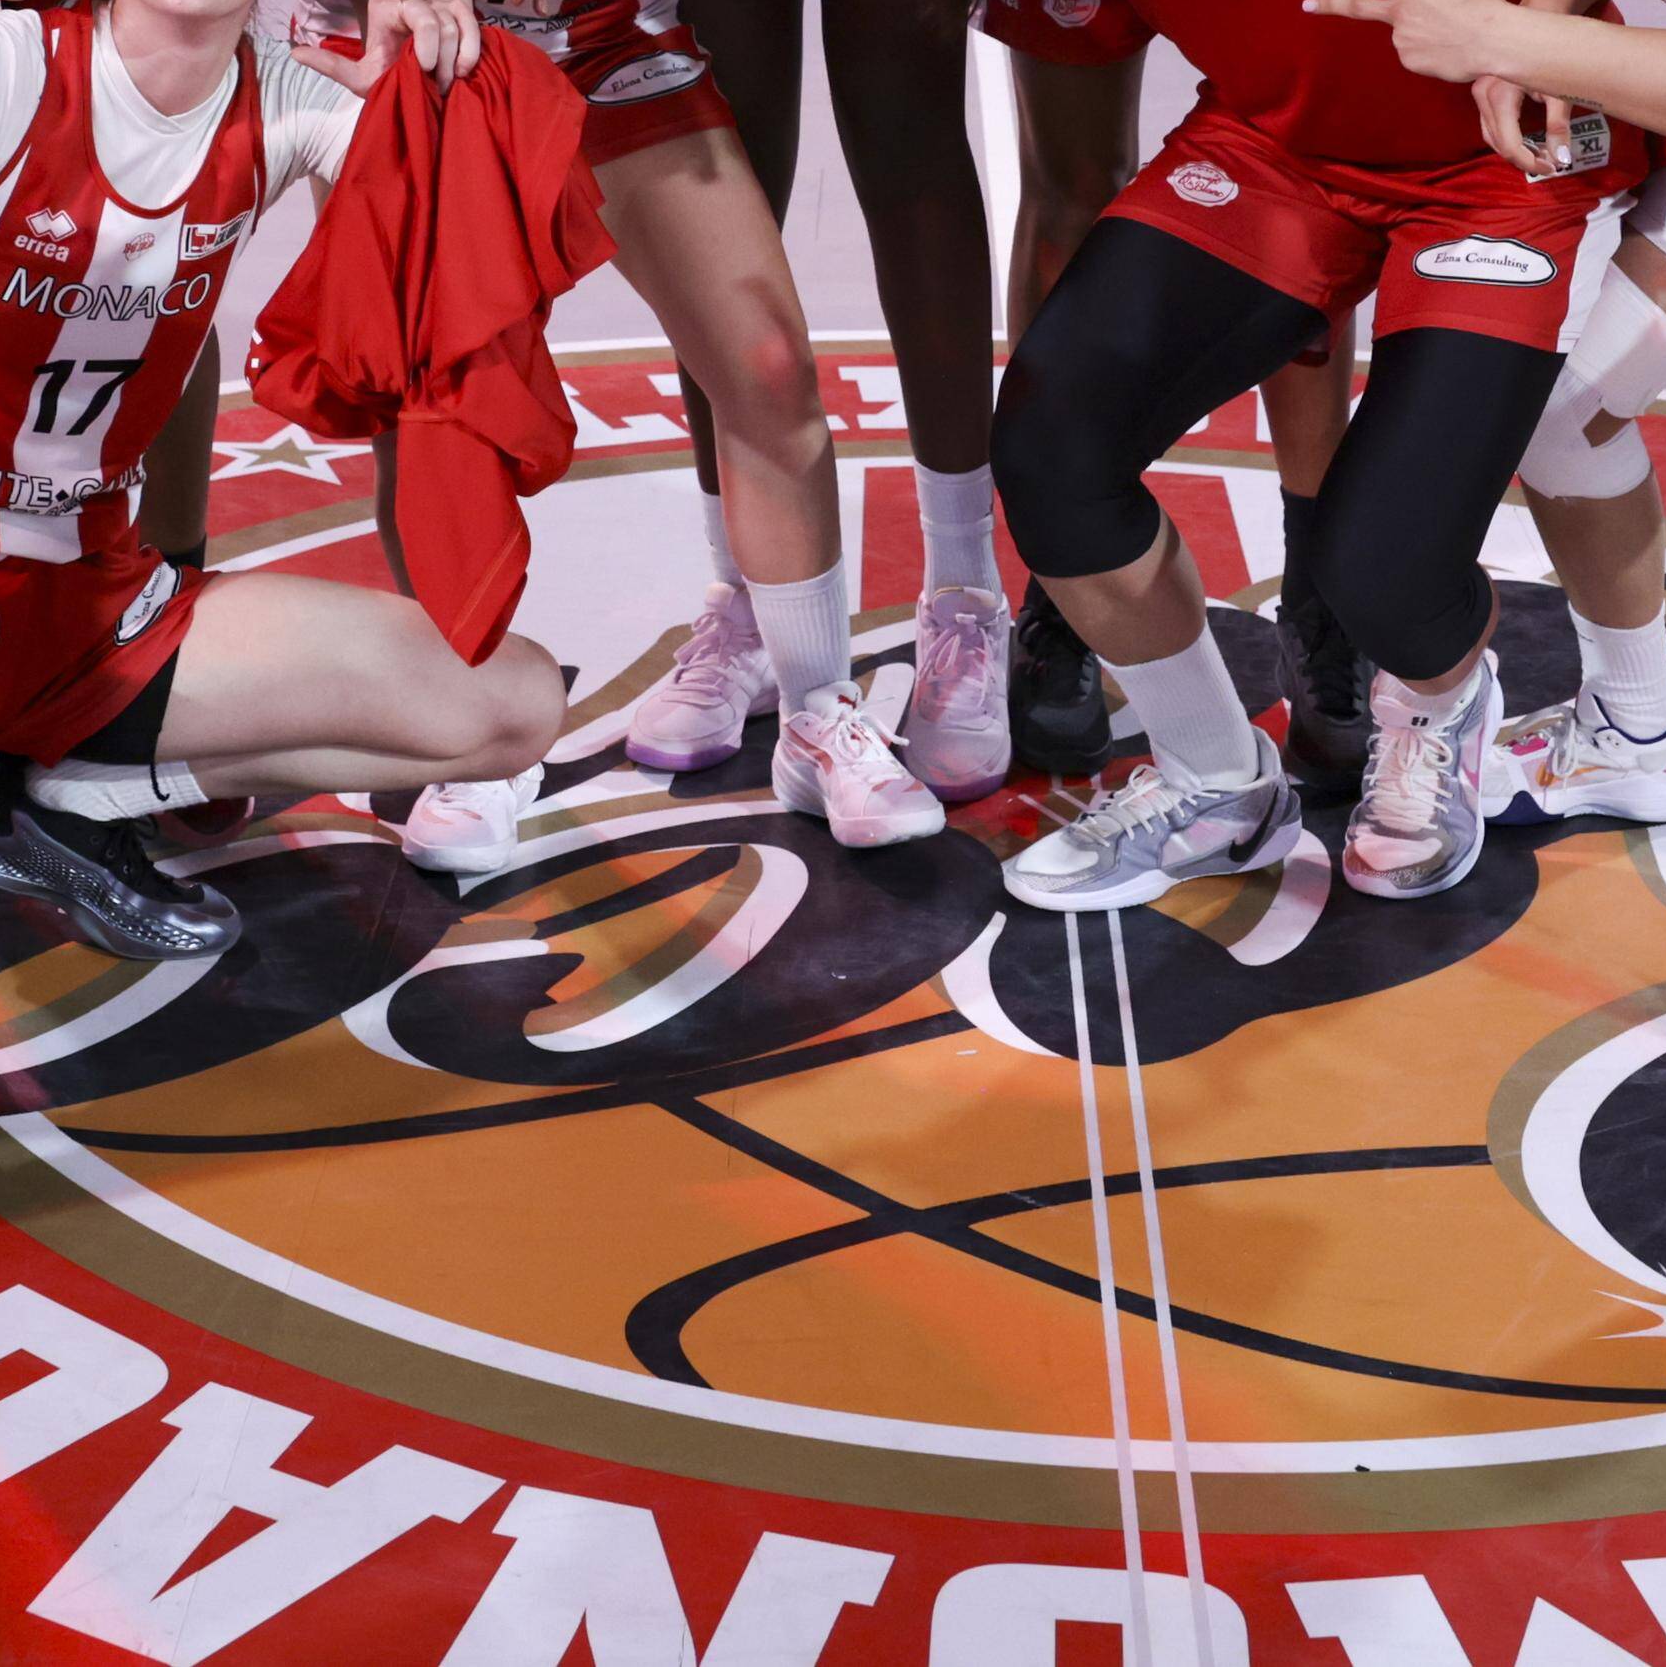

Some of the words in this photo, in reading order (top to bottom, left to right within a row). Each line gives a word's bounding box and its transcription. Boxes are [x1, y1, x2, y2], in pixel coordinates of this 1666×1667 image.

[1580, 137, 1603, 154] XL
[14, 234, 70, 262] errea
[1434, 252, 1461, 265] Elena
[1465, 253, 1530, 273] Consulting
[1, 266, 212, 321] MONACO
[33, 359, 145, 436] 17
